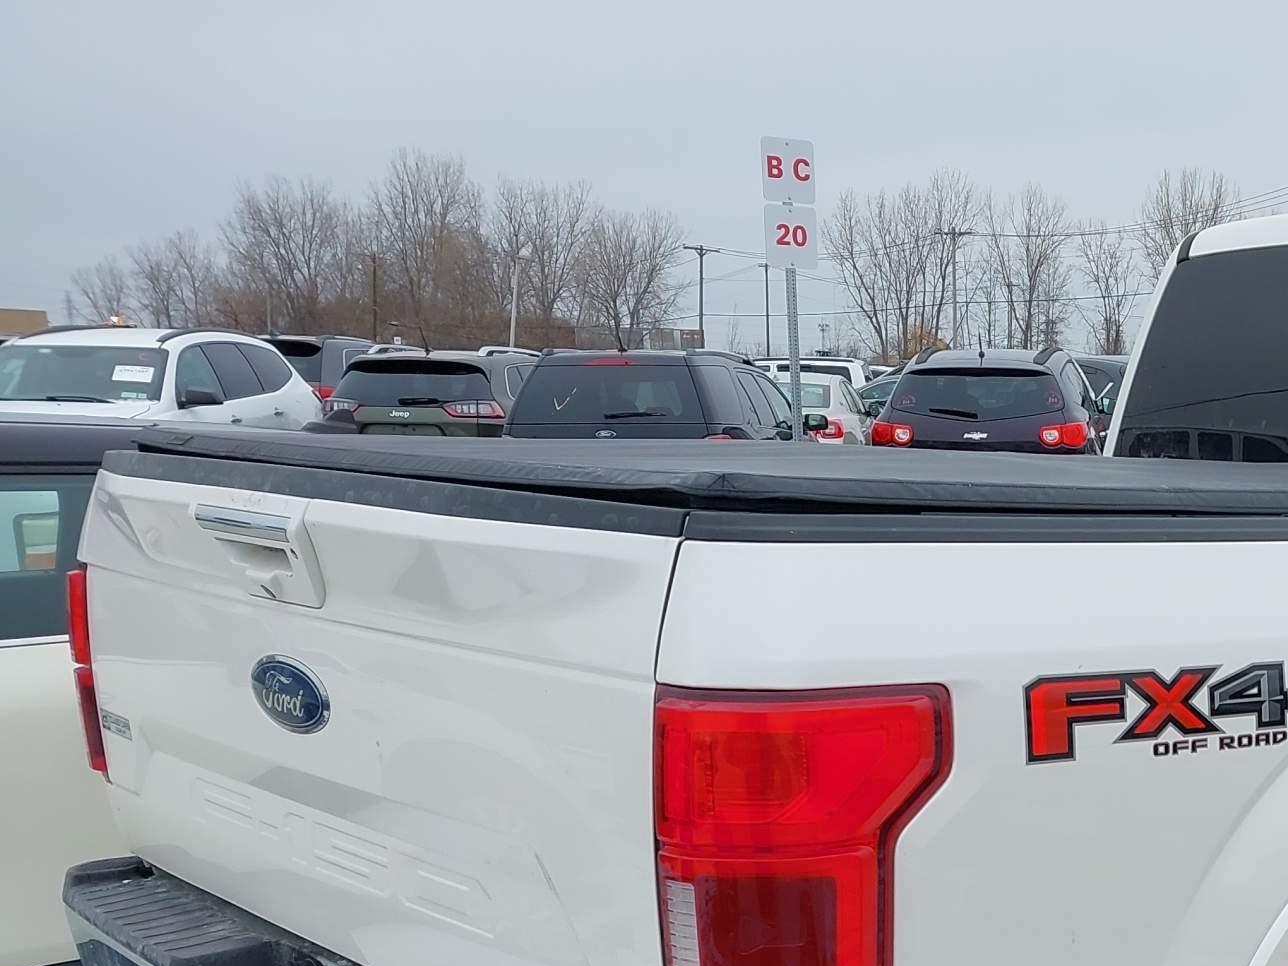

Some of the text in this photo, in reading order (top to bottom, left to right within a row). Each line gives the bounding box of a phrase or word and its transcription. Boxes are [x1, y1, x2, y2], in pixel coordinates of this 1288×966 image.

[766, 155, 811, 182] B C
[775, 223, 808, 247] 20
[389, 409, 410, 419] Jeep
[262, 670, 305, 718] Ford
[1153, 731, 1288, 757] OFF ROAD
